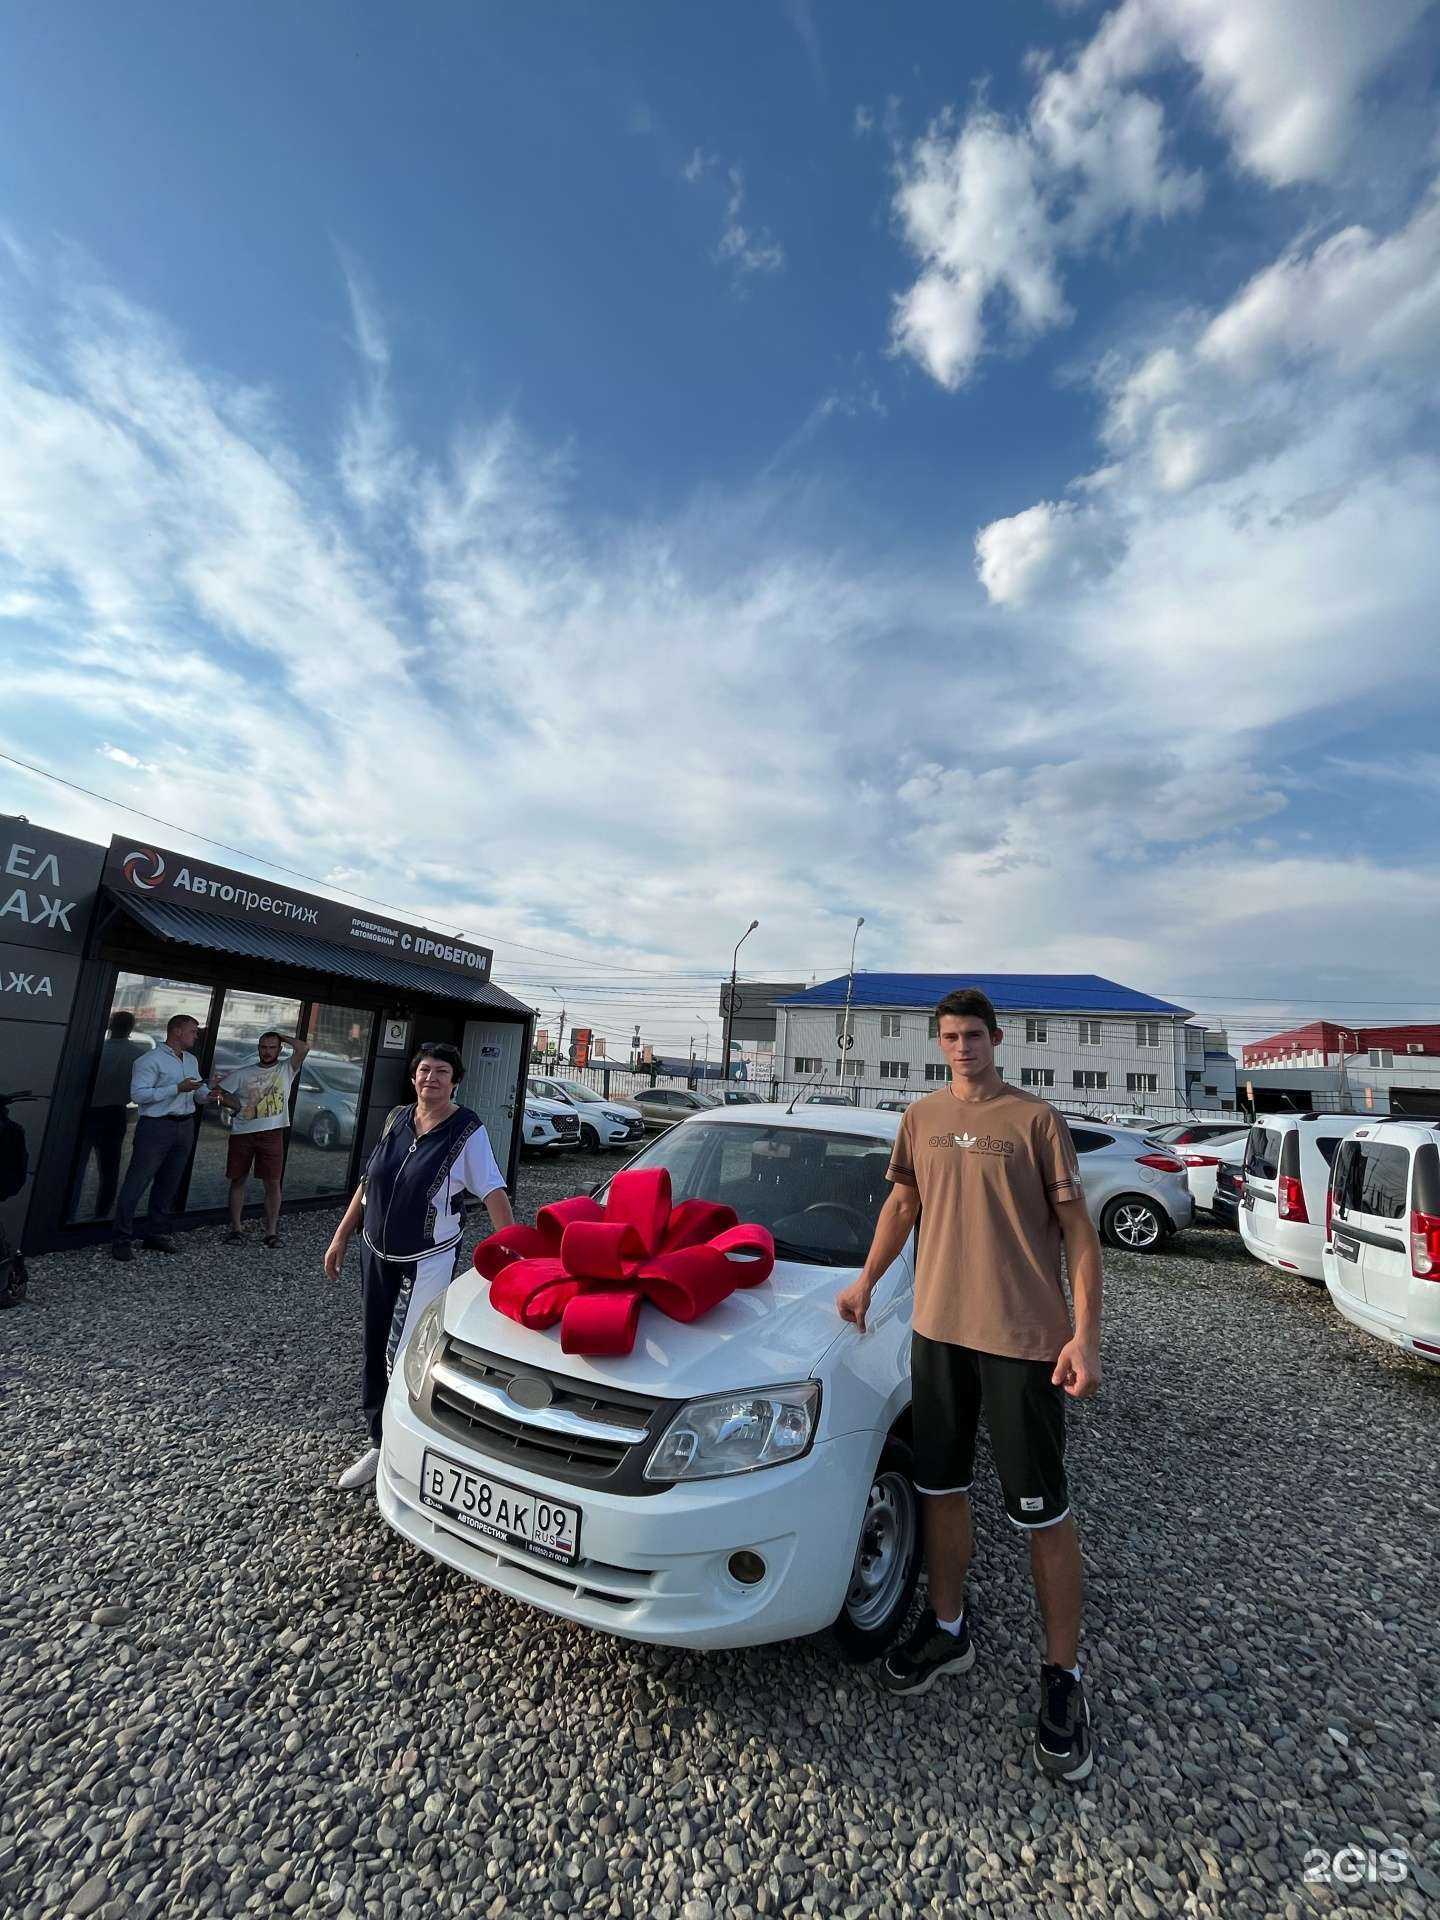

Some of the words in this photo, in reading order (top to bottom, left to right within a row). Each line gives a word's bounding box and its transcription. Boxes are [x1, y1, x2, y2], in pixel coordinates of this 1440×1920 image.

[0, 843, 61, 887] ЕЛ
[350, 928, 395, 946] АВТОМОБИЛИ
[351, 918, 399, 938] ПРОВЕРЕННЫЕ
[401, 933, 412, 950] С
[414, 937, 487, 971] ПРОБЕГОМ
[457, 1512, 508, 1542] АВТОПРЕСТИЖ
[537, 1504, 567, 1537] 09
[535, 1529, 556, 1546] RUS
